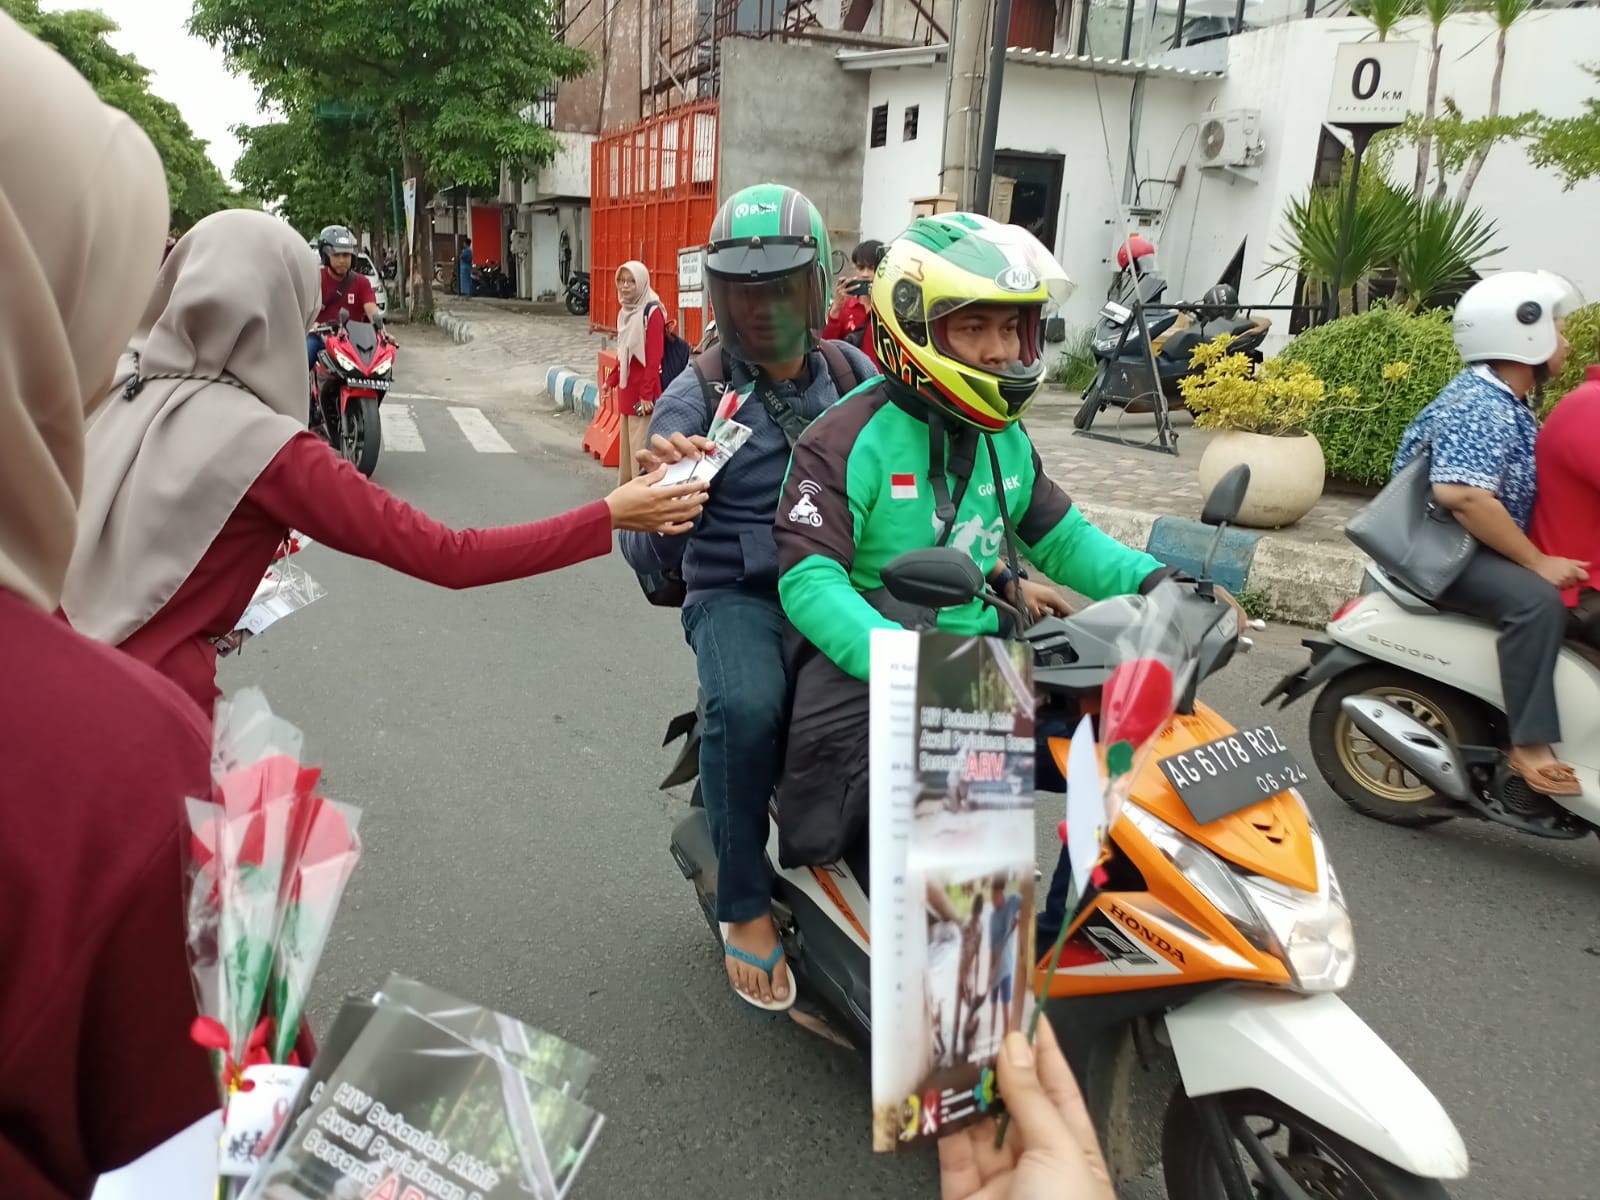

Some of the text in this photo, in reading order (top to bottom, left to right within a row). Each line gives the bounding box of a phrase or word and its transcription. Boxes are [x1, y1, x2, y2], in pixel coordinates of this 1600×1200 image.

[1351, 57, 1403, 101] 0 KM
[1367, 633, 1452, 667] SCOOPY
[965, 751, 1006, 781] ARV
[1166, 725, 1288, 789] AG 6178 RCZ
[1109, 903, 1186, 965] HONDA
[316, 1105, 375, 1151] Awali
[333, 1081, 374, 1116] HIV
[366, 1101, 451, 1165] Bukanlah
[447, 1151, 501, 1193] Akhir
[302, 1127, 383, 1190] Bersama
